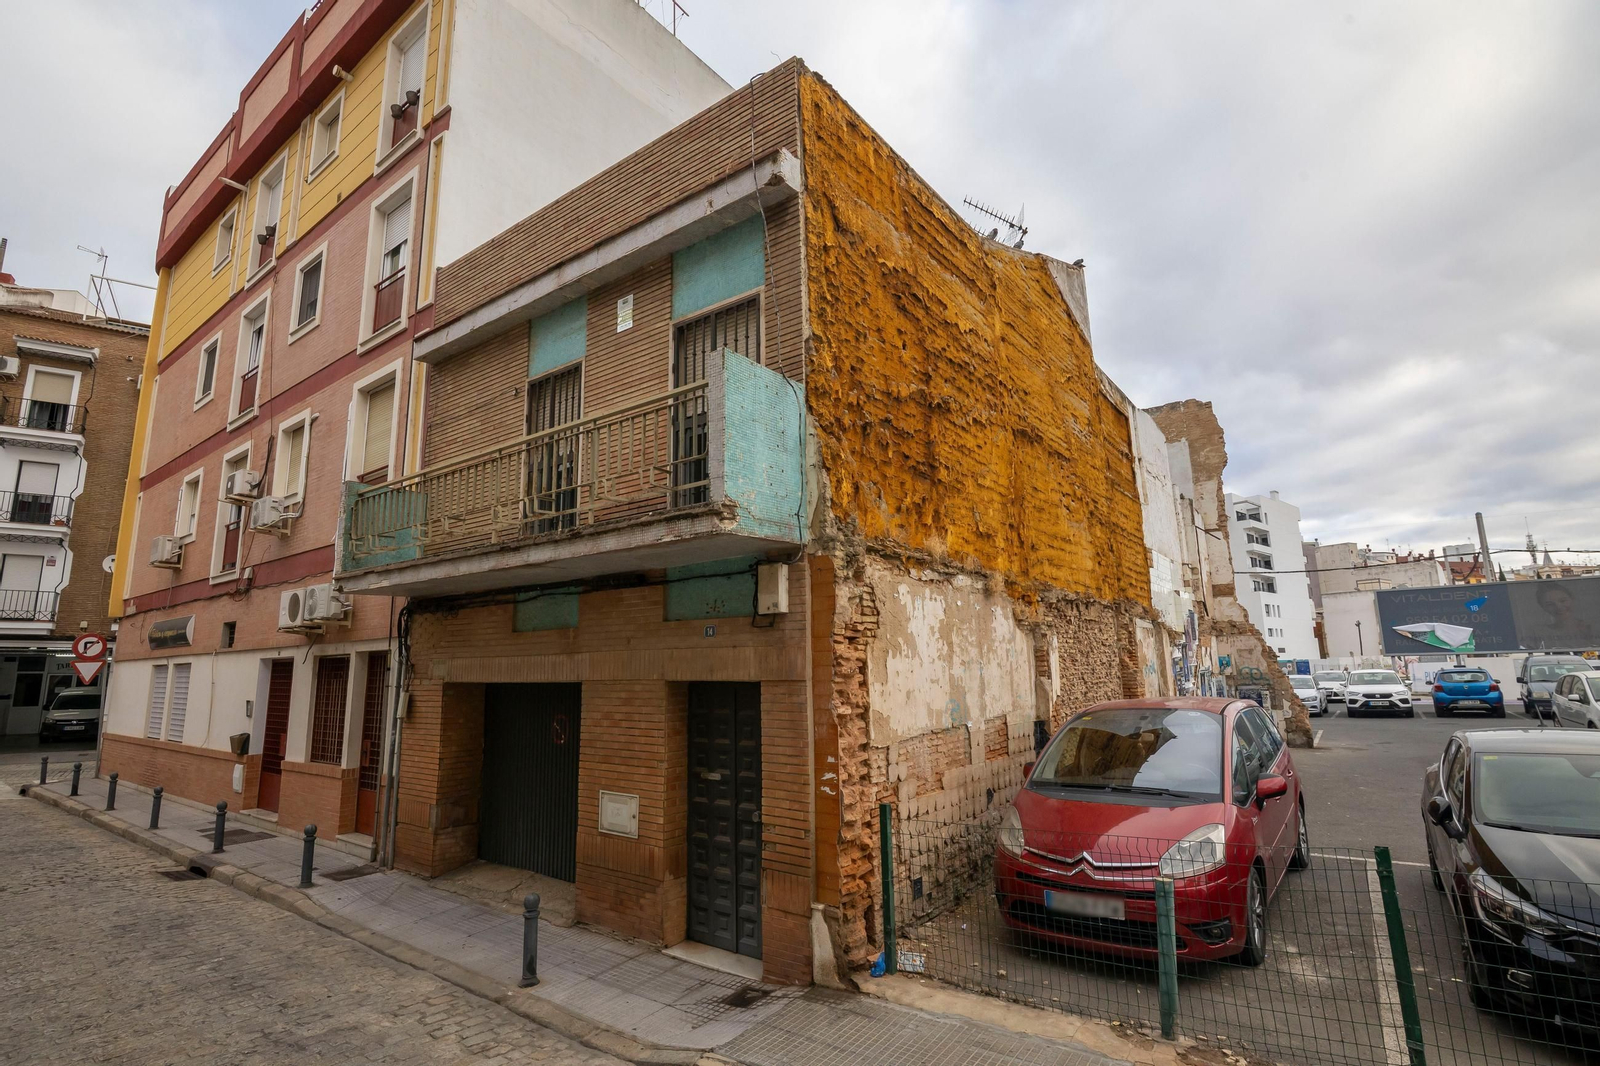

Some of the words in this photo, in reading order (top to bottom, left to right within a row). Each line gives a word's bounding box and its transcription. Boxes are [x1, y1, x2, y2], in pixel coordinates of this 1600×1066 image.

[1390, 590, 1492, 603] VITALDENT
[1470, 604, 1479, 612] 18
[1451, 614, 1469, 623] 02
[1471, 613, 1489, 623] 08
